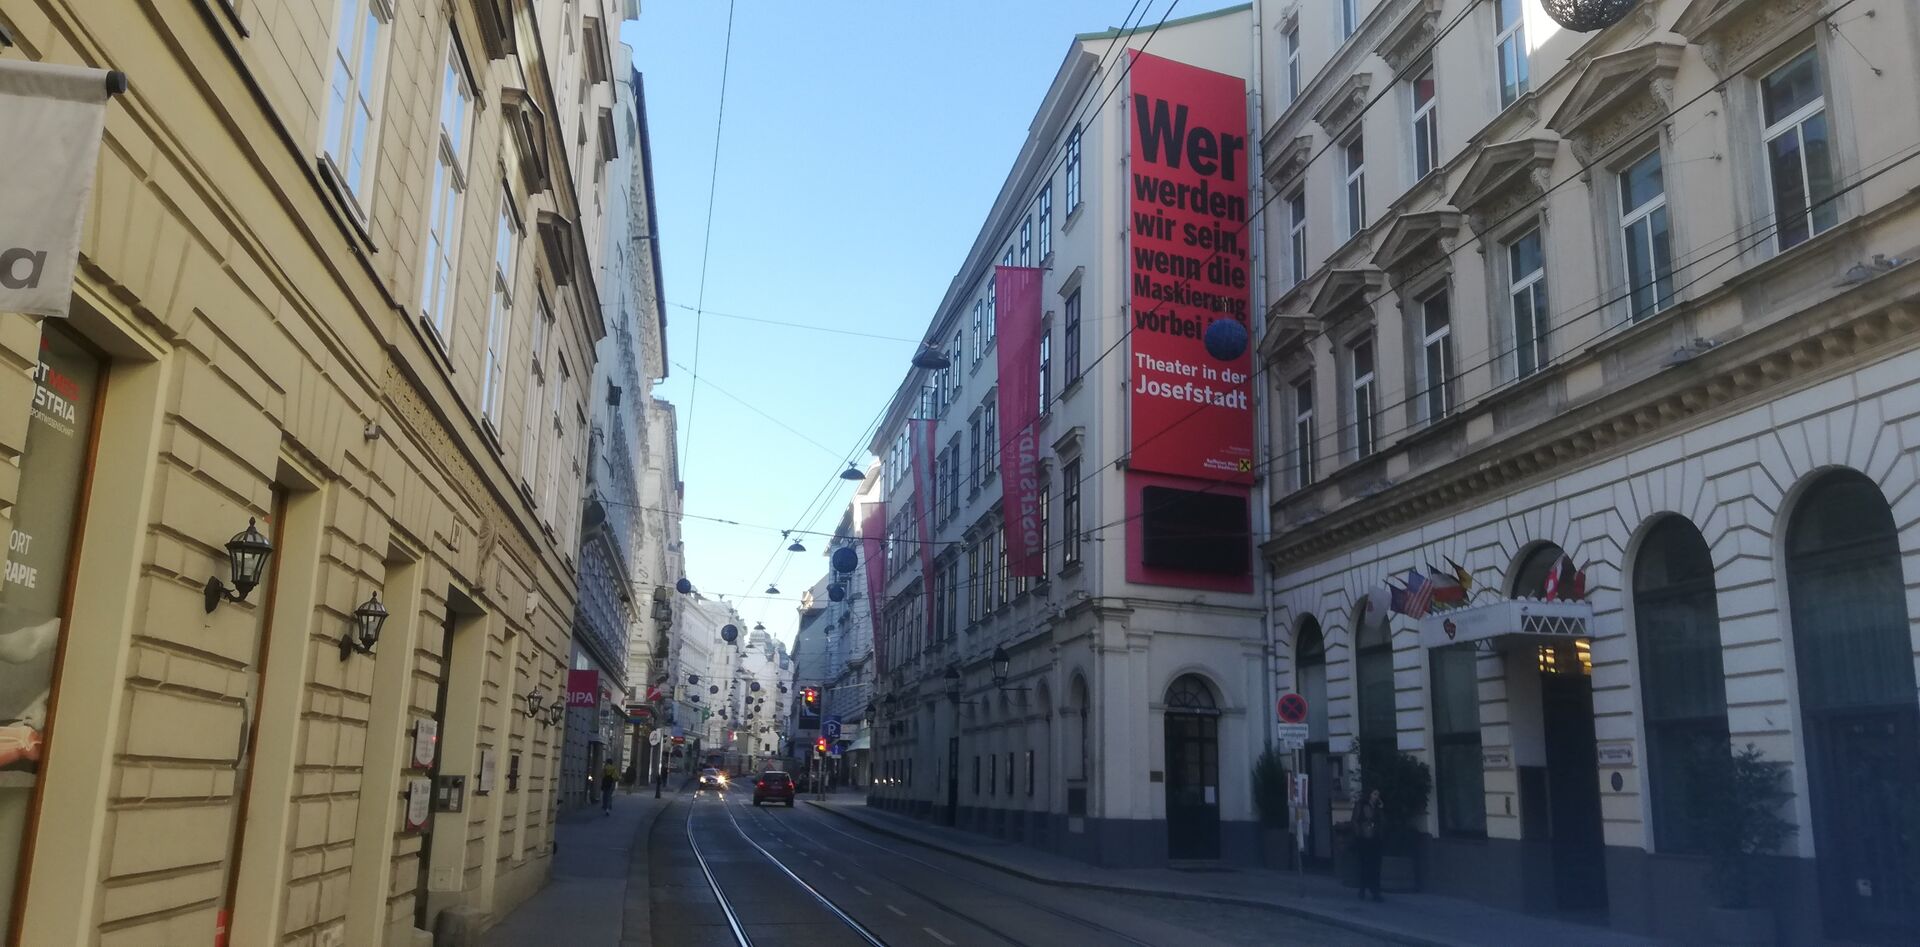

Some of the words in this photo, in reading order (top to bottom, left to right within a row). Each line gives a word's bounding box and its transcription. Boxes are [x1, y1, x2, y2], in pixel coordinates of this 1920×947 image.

[1134, 93, 1244, 181] Wer
[1133, 173, 1246, 223] werden
[1133, 209, 1176, 241] wir
[1183, 222, 1246, 261] sein,
[0, 247, 48, 289] a
[1134, 247, 1200, 281] wenn
[1208, 256, 1245, 289] die
[1134, 273, 1246, 320] Maskierung
[1134, 310, 1202, 340] vorbei
[1135, 352, 1197, 377] Theater
[1203, 364, 1216, 380] in
[1221, 368, 1247, 384] der
[33, 384, 75, 425] STRIA
[1136, 374, 1247, 409] Josefstadt
[10, 529, 33, 555] ORT
[5, 559, 37, 589] RAPIE
